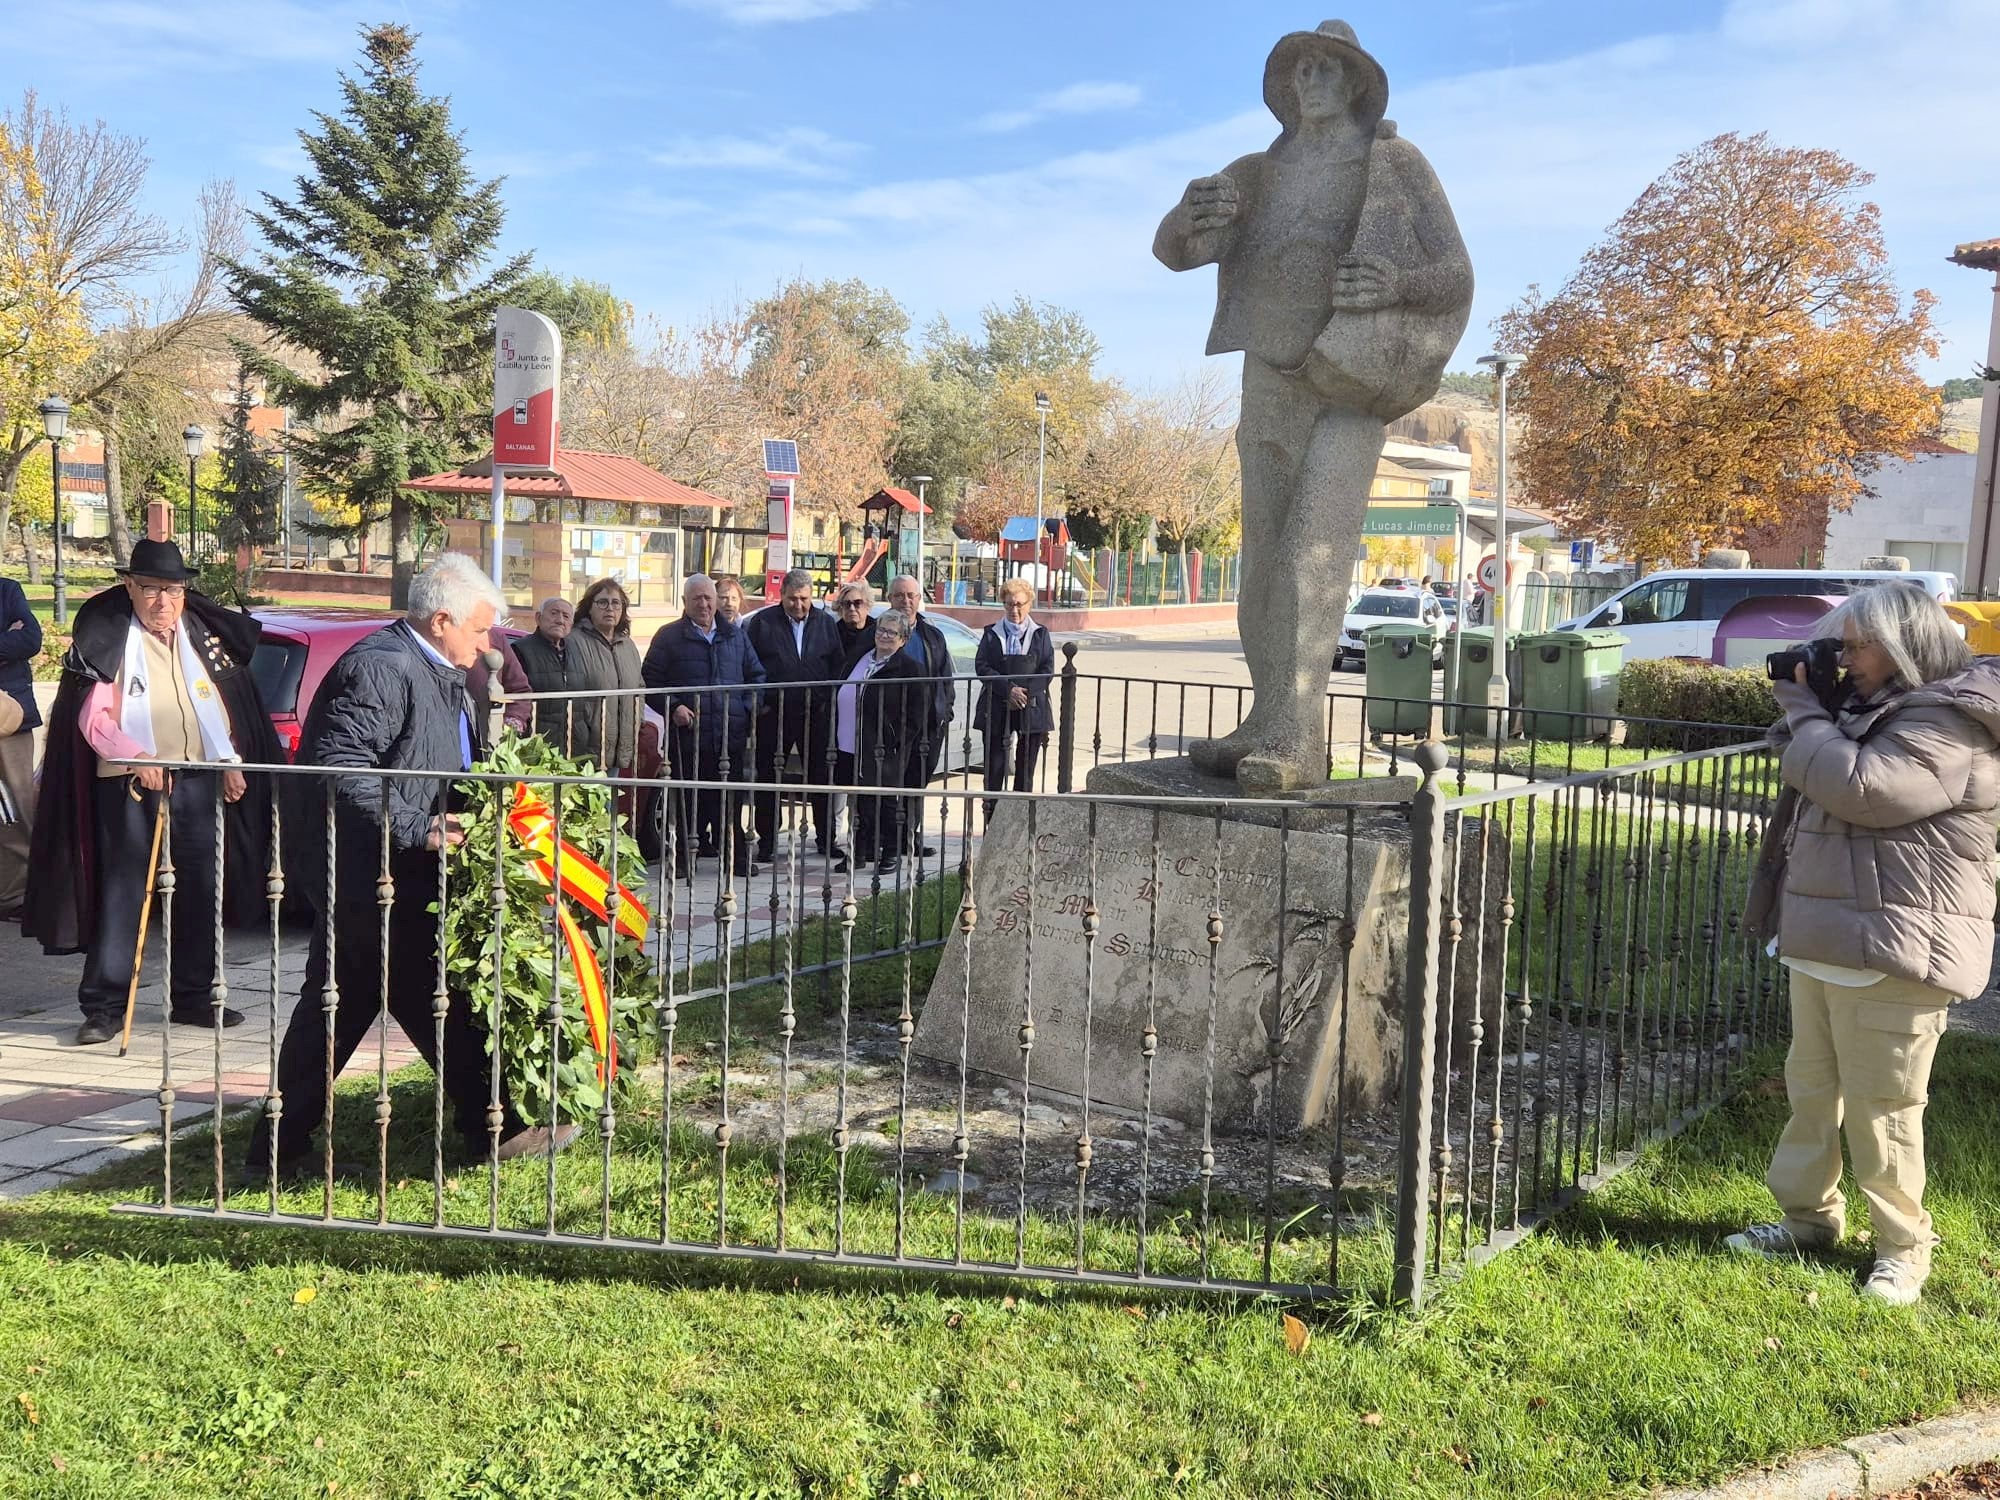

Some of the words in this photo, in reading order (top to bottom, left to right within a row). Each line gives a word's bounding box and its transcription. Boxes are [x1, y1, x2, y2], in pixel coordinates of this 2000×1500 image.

[517, 354, 538, 362] Junta
[541, 354, 552, 362] de
[498, 361, 521, 369] Castilla
[1371, 520, 1402, 532] Lucas
[1407, 520, 1452, 532] Jiménez
